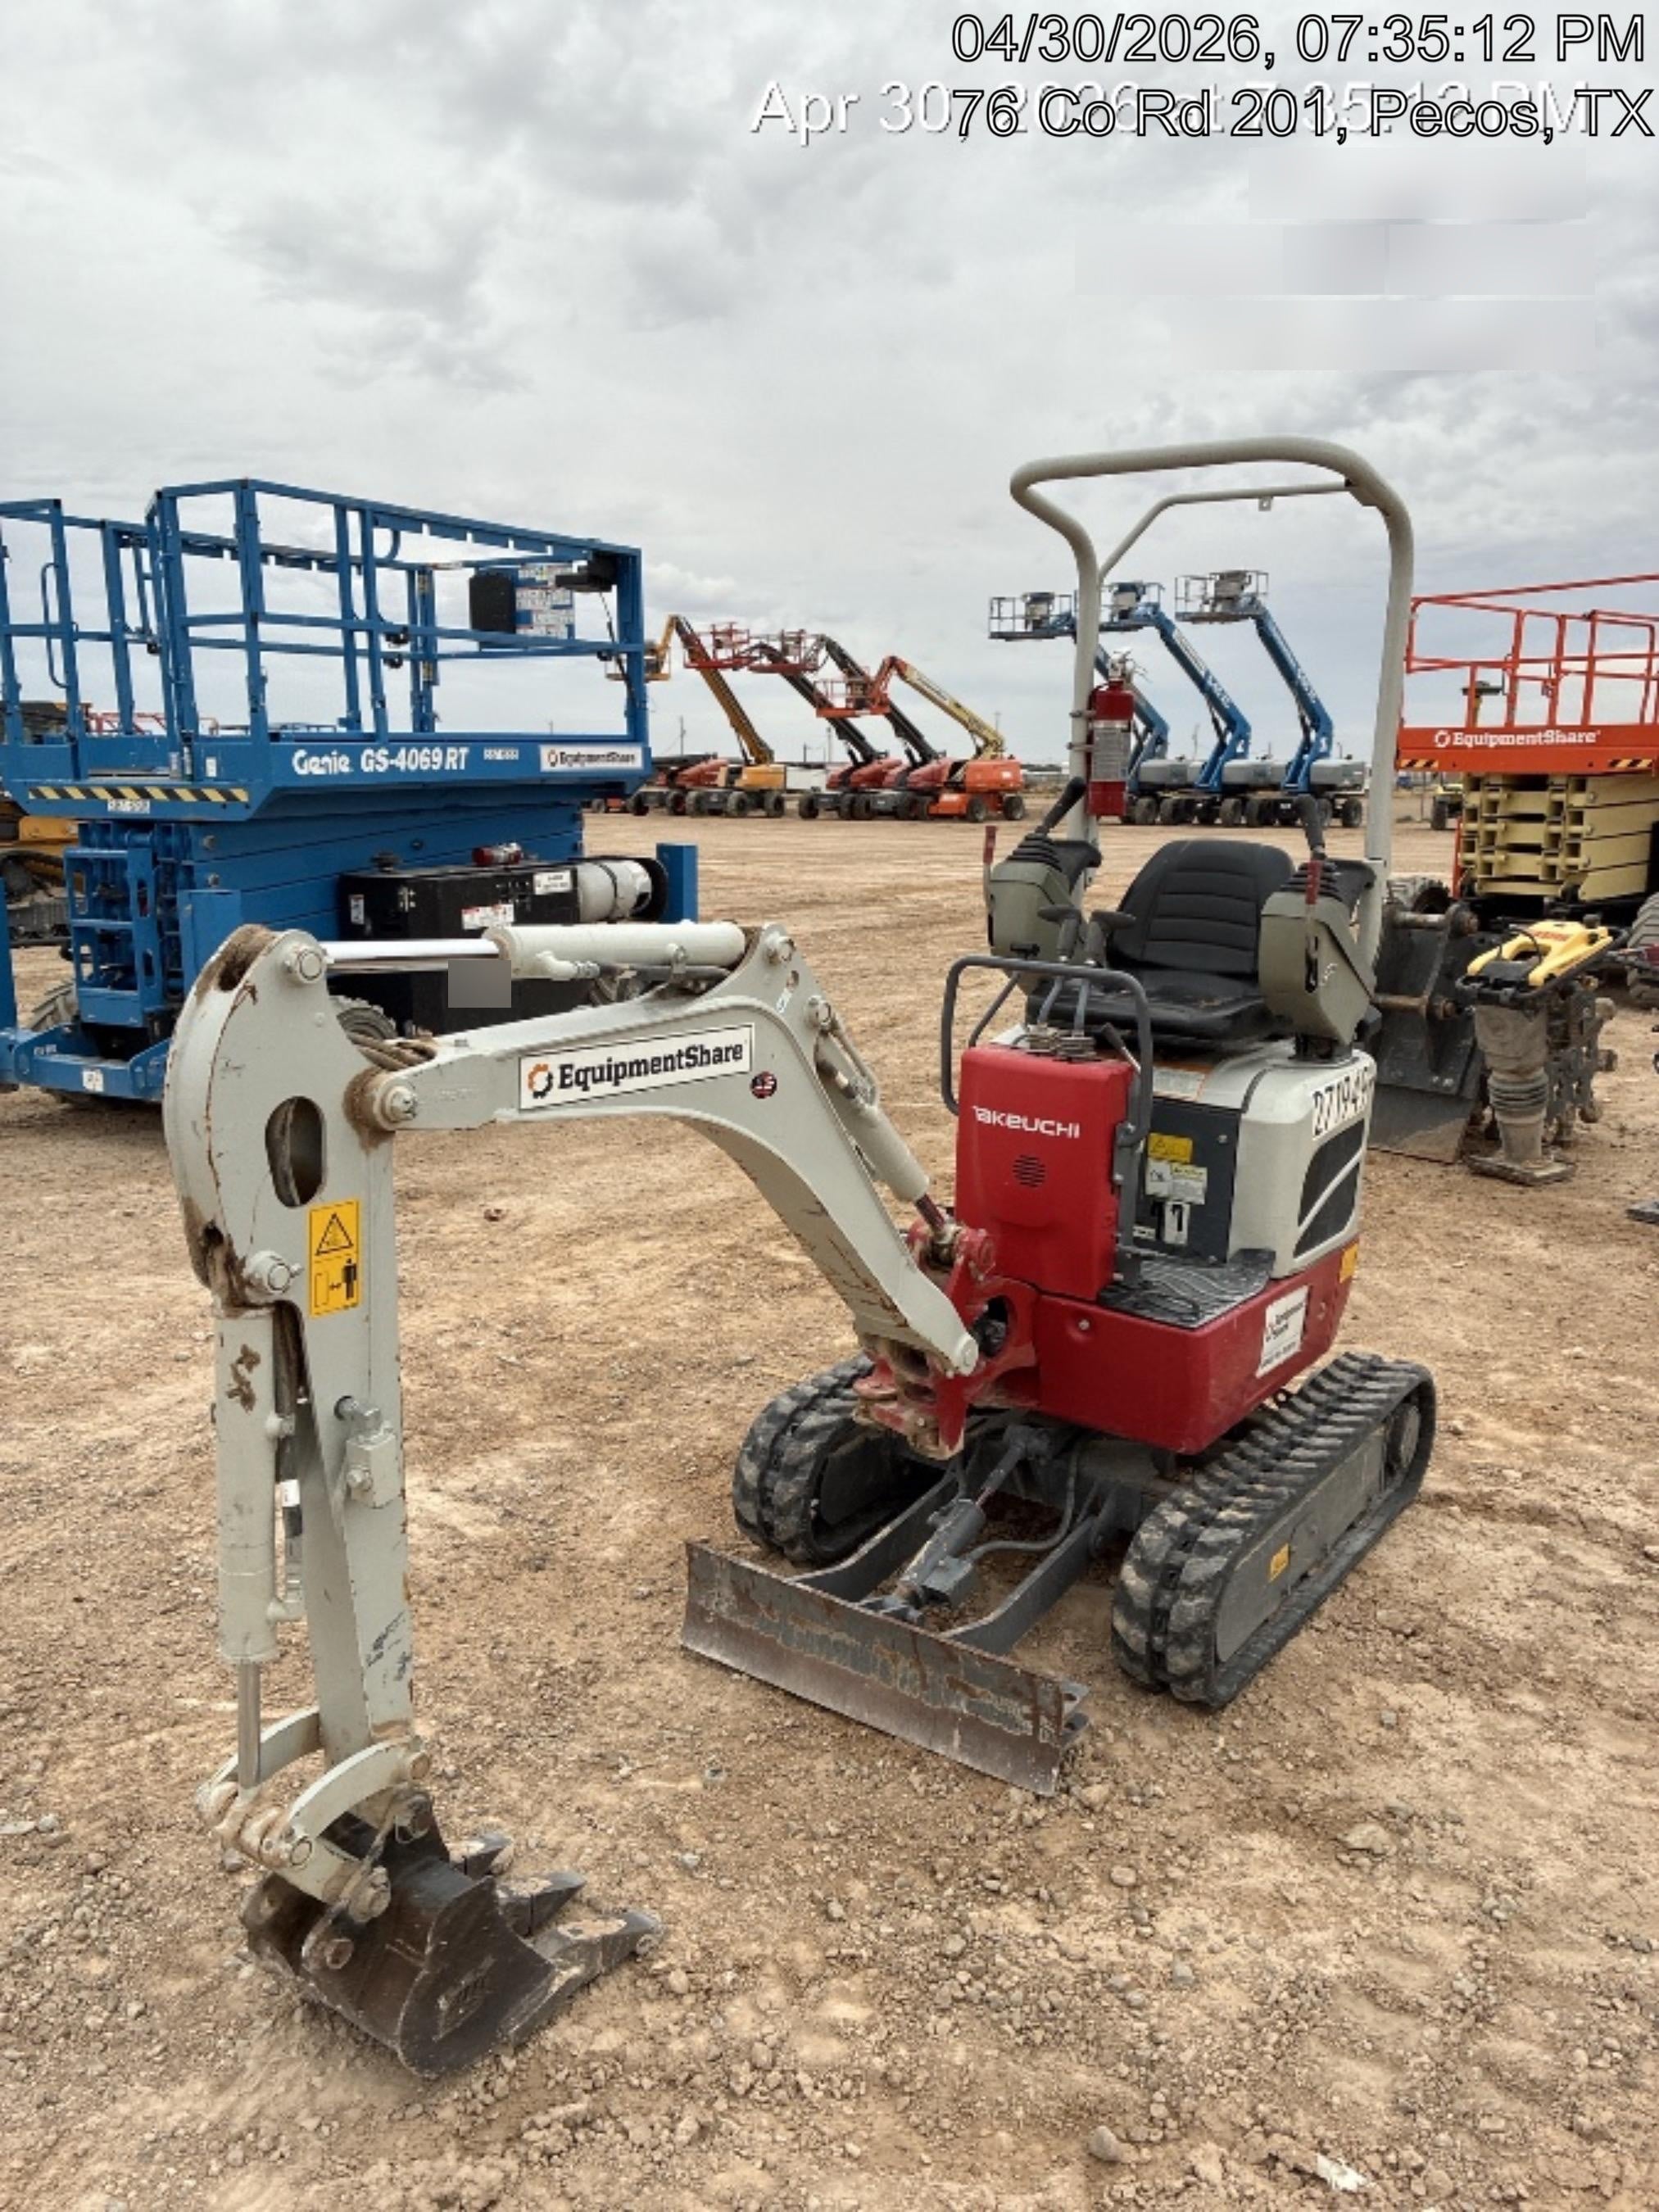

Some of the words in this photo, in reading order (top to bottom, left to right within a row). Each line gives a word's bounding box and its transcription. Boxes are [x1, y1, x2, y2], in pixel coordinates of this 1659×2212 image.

[1453, 729, 1596, 747] EquipmentShare
[292, 748, 353, 775] Genie
[360, 746, 443, 773] GS-4069
[444, 746, 469, 770] RT
[558, 1043, 743, 1091] EquipmentShare
